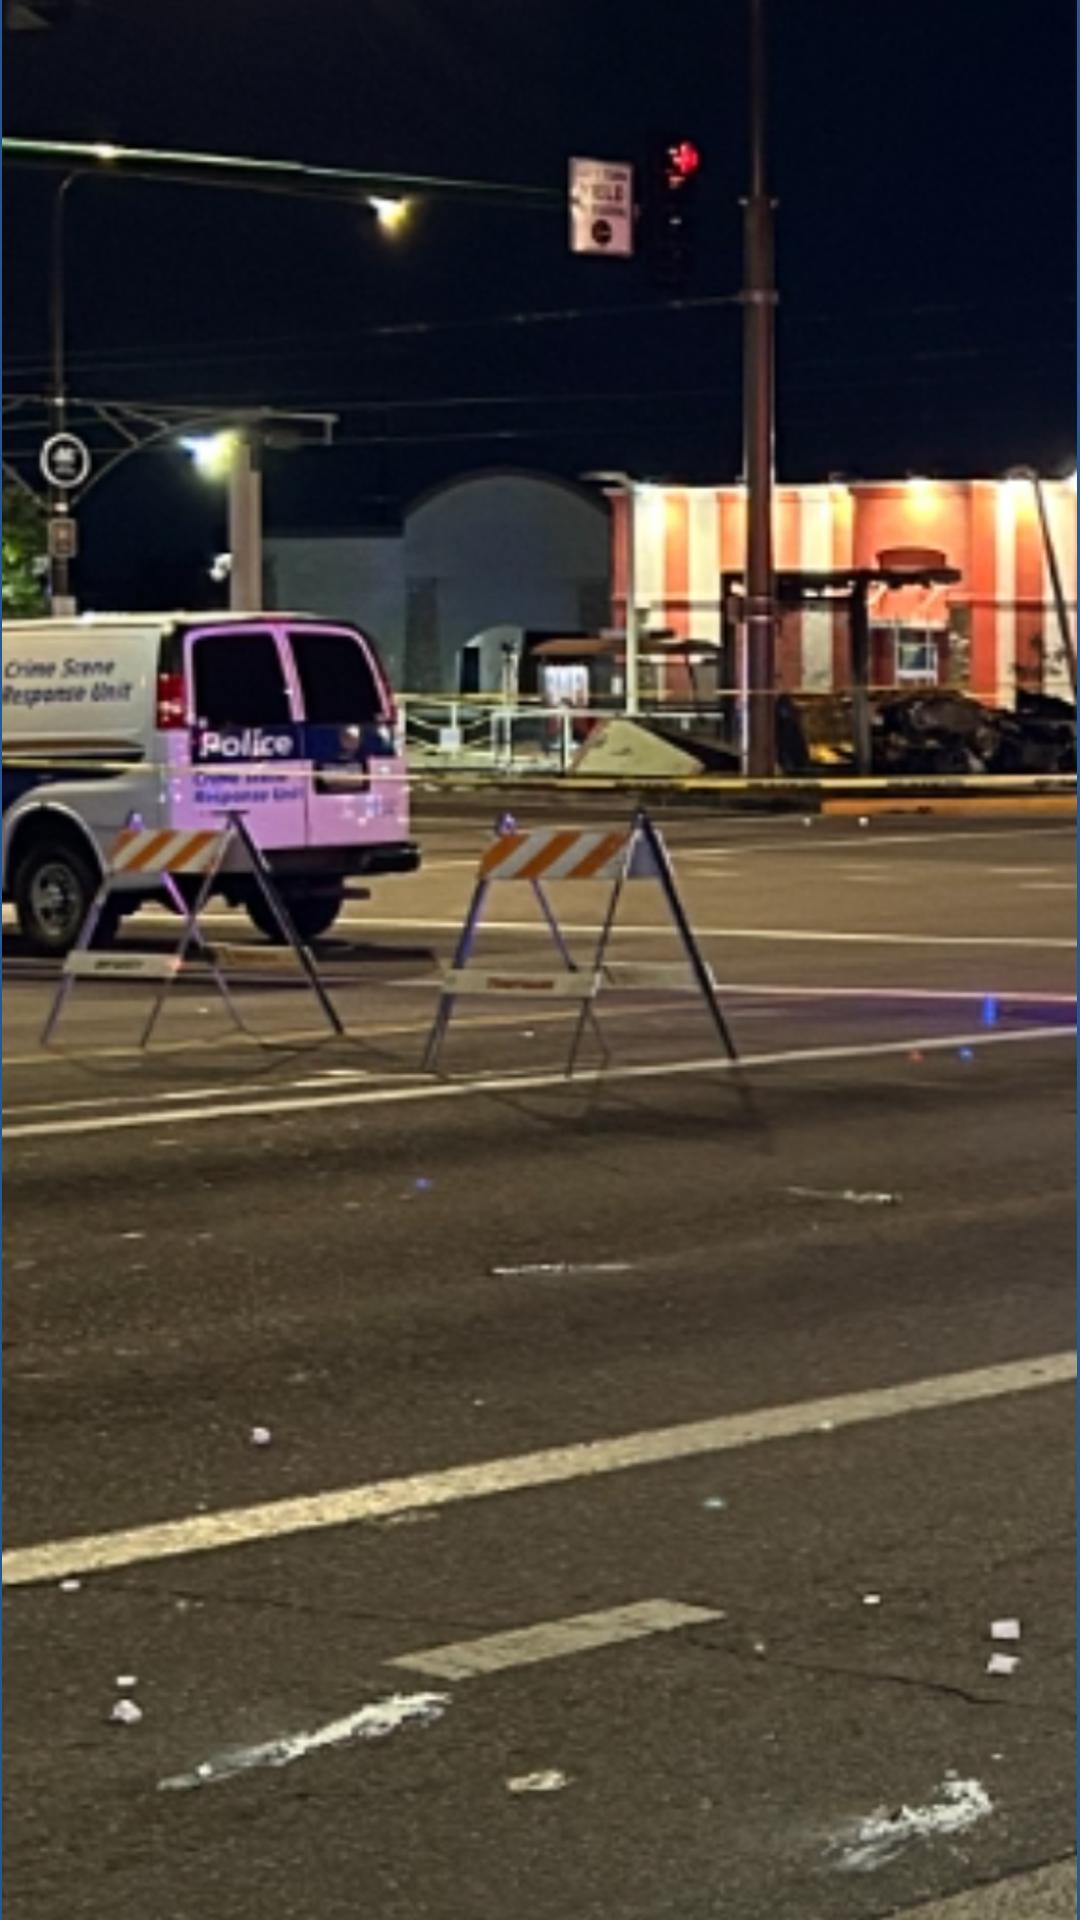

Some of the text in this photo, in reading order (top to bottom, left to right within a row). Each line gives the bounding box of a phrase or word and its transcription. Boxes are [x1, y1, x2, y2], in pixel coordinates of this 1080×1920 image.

[5, 658, 115, 679] Crime Scene
[3, 681, 133, 709] Response Unit
[199, 728, 293, 757] Police
